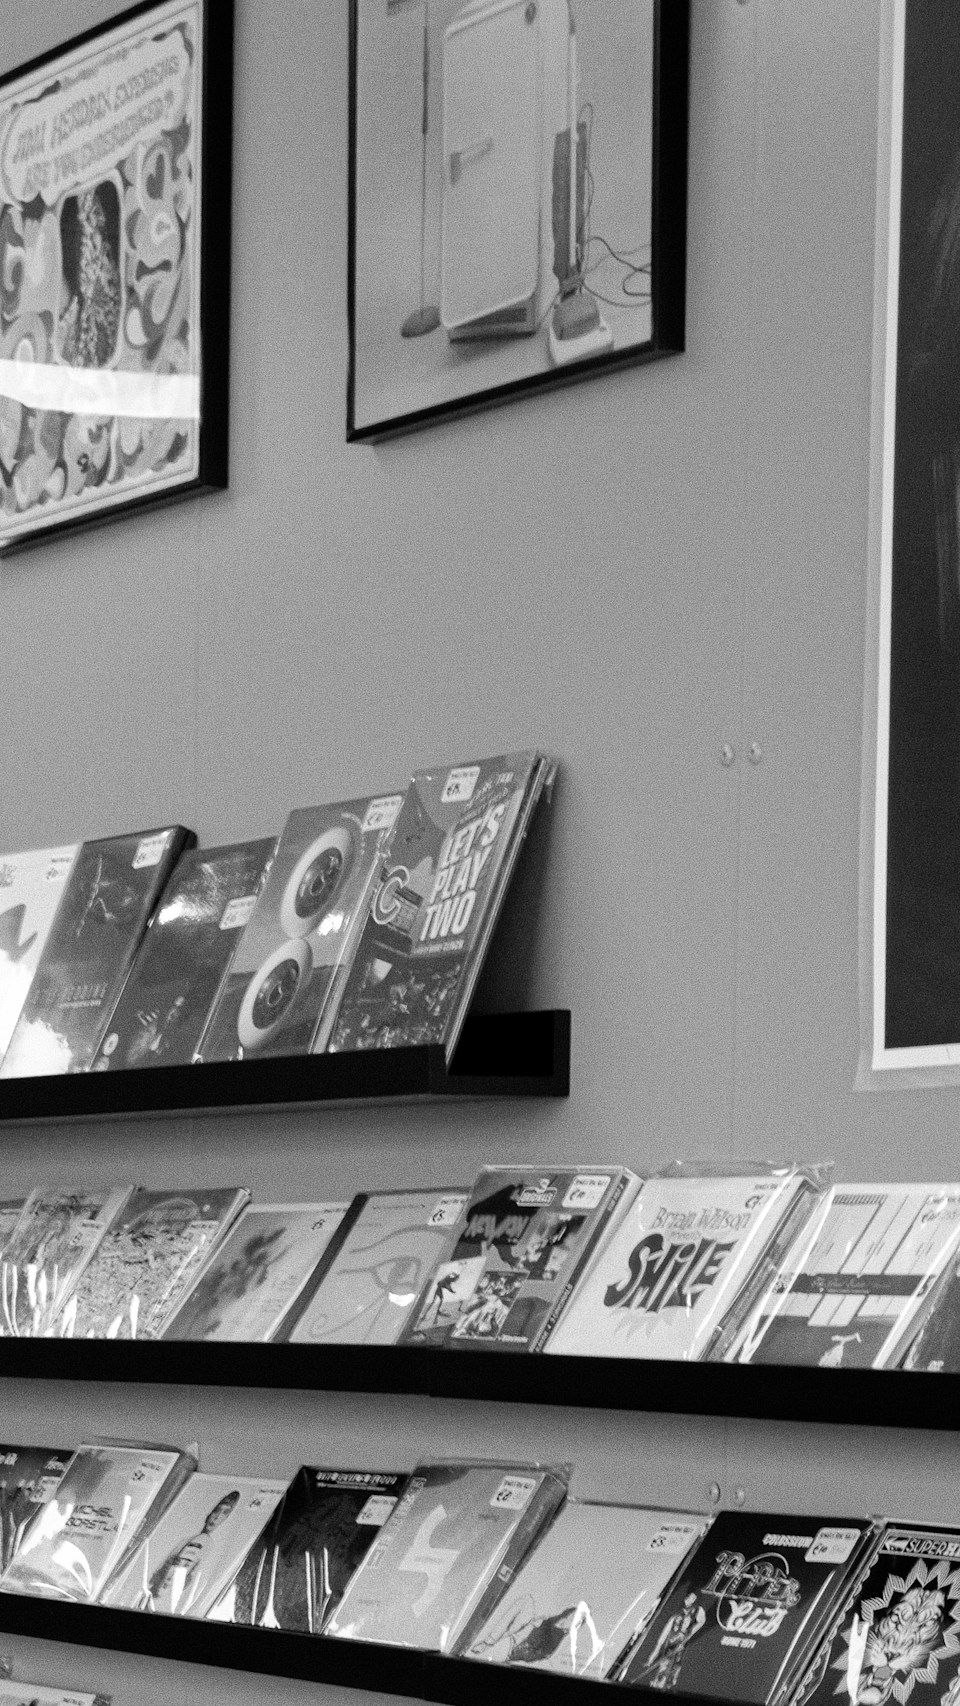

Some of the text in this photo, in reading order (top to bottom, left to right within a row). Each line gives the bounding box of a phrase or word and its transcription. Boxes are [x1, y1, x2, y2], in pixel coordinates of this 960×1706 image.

[440, 804, 505, 870] LET'S
[429, 846, 493, 907] PLAY
[419, 889, 477, 942] TWO
[650, 1206, 752, 1231] Brian Wilson
